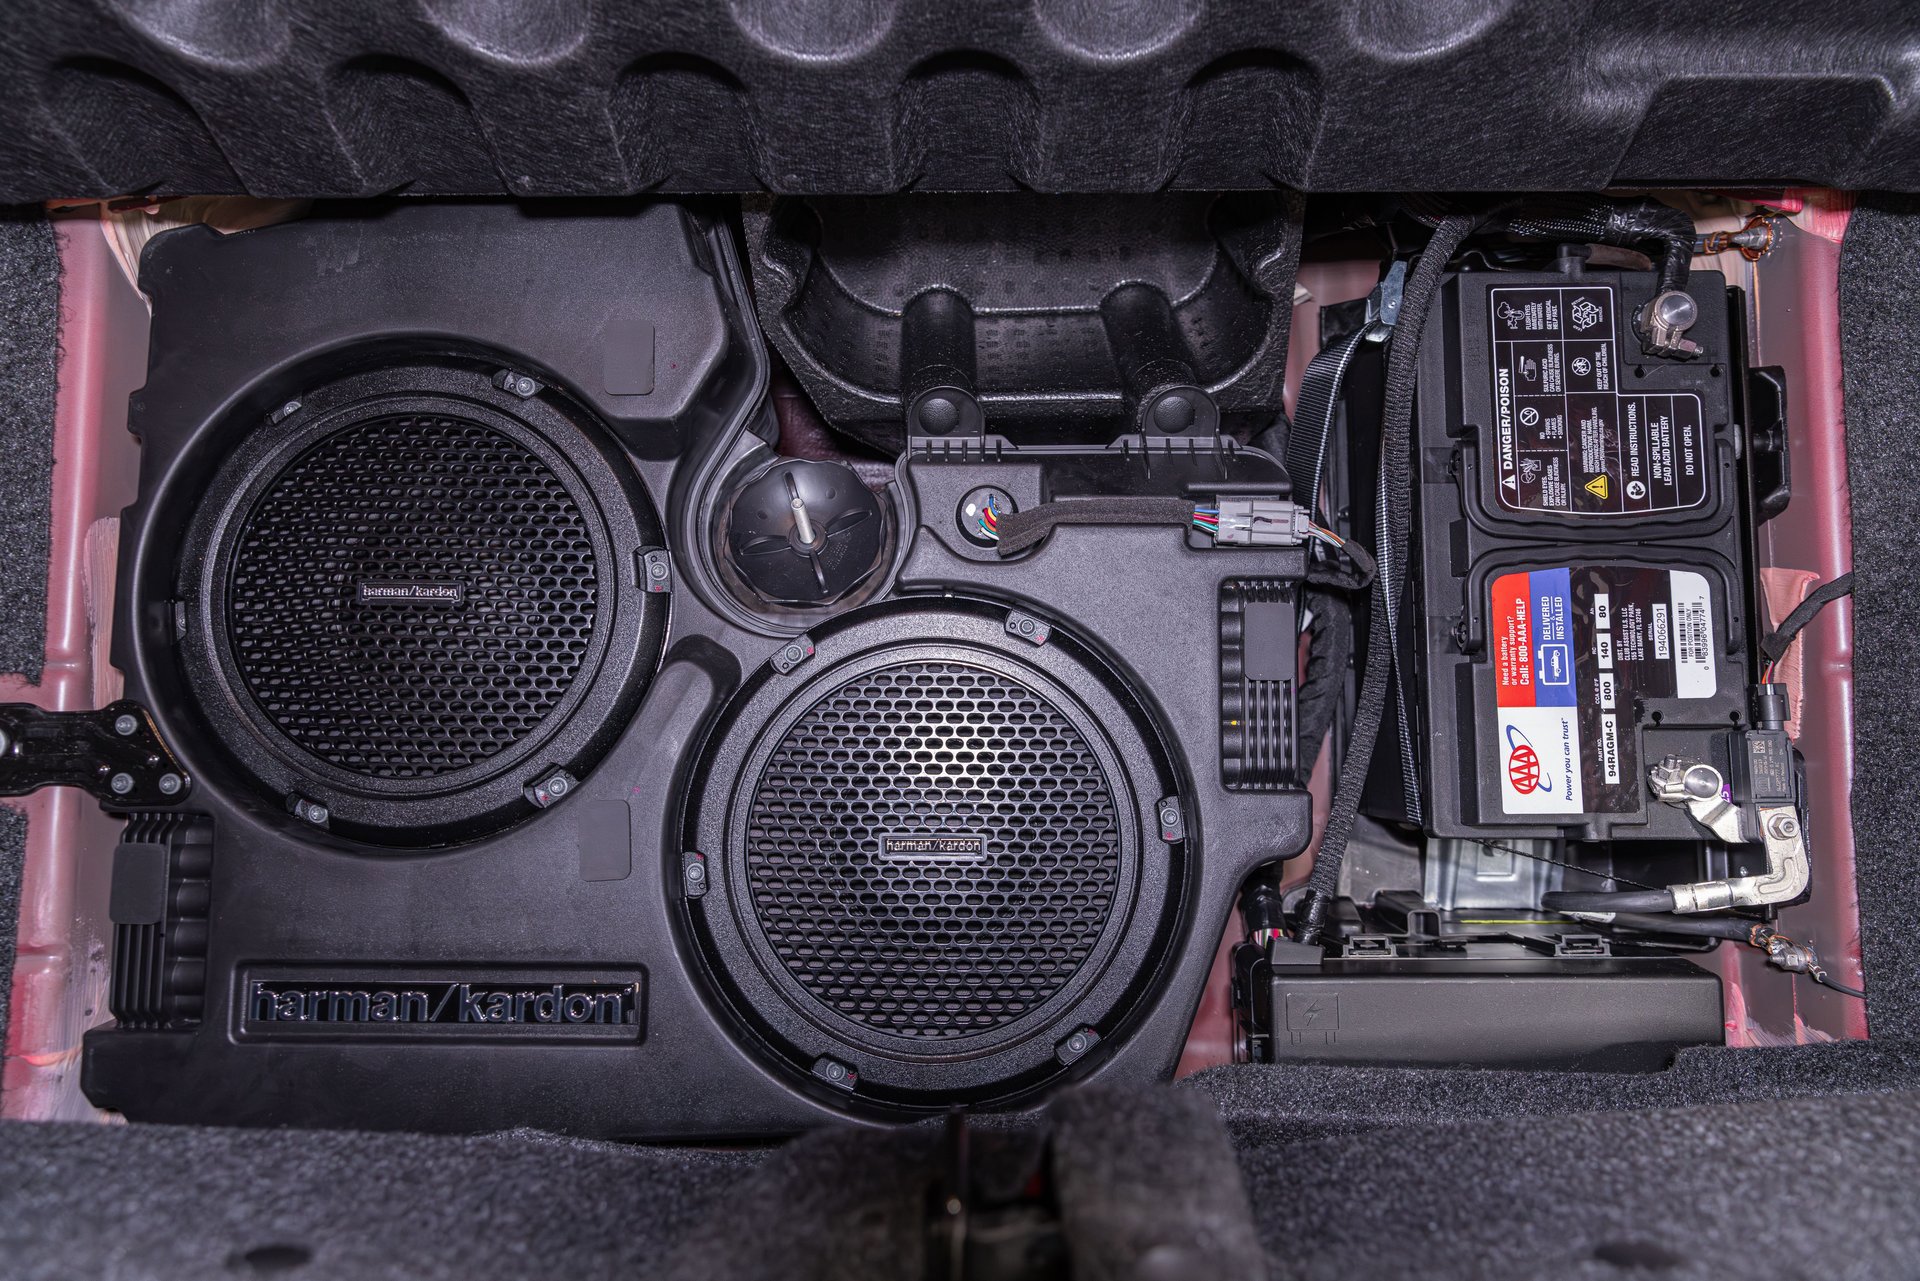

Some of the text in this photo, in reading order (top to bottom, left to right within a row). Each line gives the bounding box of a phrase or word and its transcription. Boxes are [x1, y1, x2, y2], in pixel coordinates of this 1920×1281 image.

[1499, 369, 1512, 469] DANGER/POISON
[1628, 402, 1639, 476] READ INSTRUCTIONS.
[1651, 423, 1661, 478] NON-SPILLABLE
[1660, 416, 1672, 485] LEAD ACID BATTERY
[1683, 425, 1694, 475] DO NOT OPEN.
[363, 585, 458, 598] harman/kardon
[1599, 606, 1606, 618] 80
[1507, 616, 1516, 645] support?
[1542, 597, 1551, 640] DELIVERED
[1555, 597, 1564, 639] INSTALLED
[1656, 608, 1667, 656] 194066291
[1501, 636, 1509, 660] battery
[1509, 647, 1517, 676] warranty
[1516, 598, 1529, 685] Call: 800-AAA-HELP
[1601, 642, 1609, 659] 140
[1509, 750, 1539, 789] AAA
[1606, 721, 1616, 776] 94RAGM-C
[886, 839, 980, 851] harman/kardon
[251, 983, 622, 1021] harman/kardon
